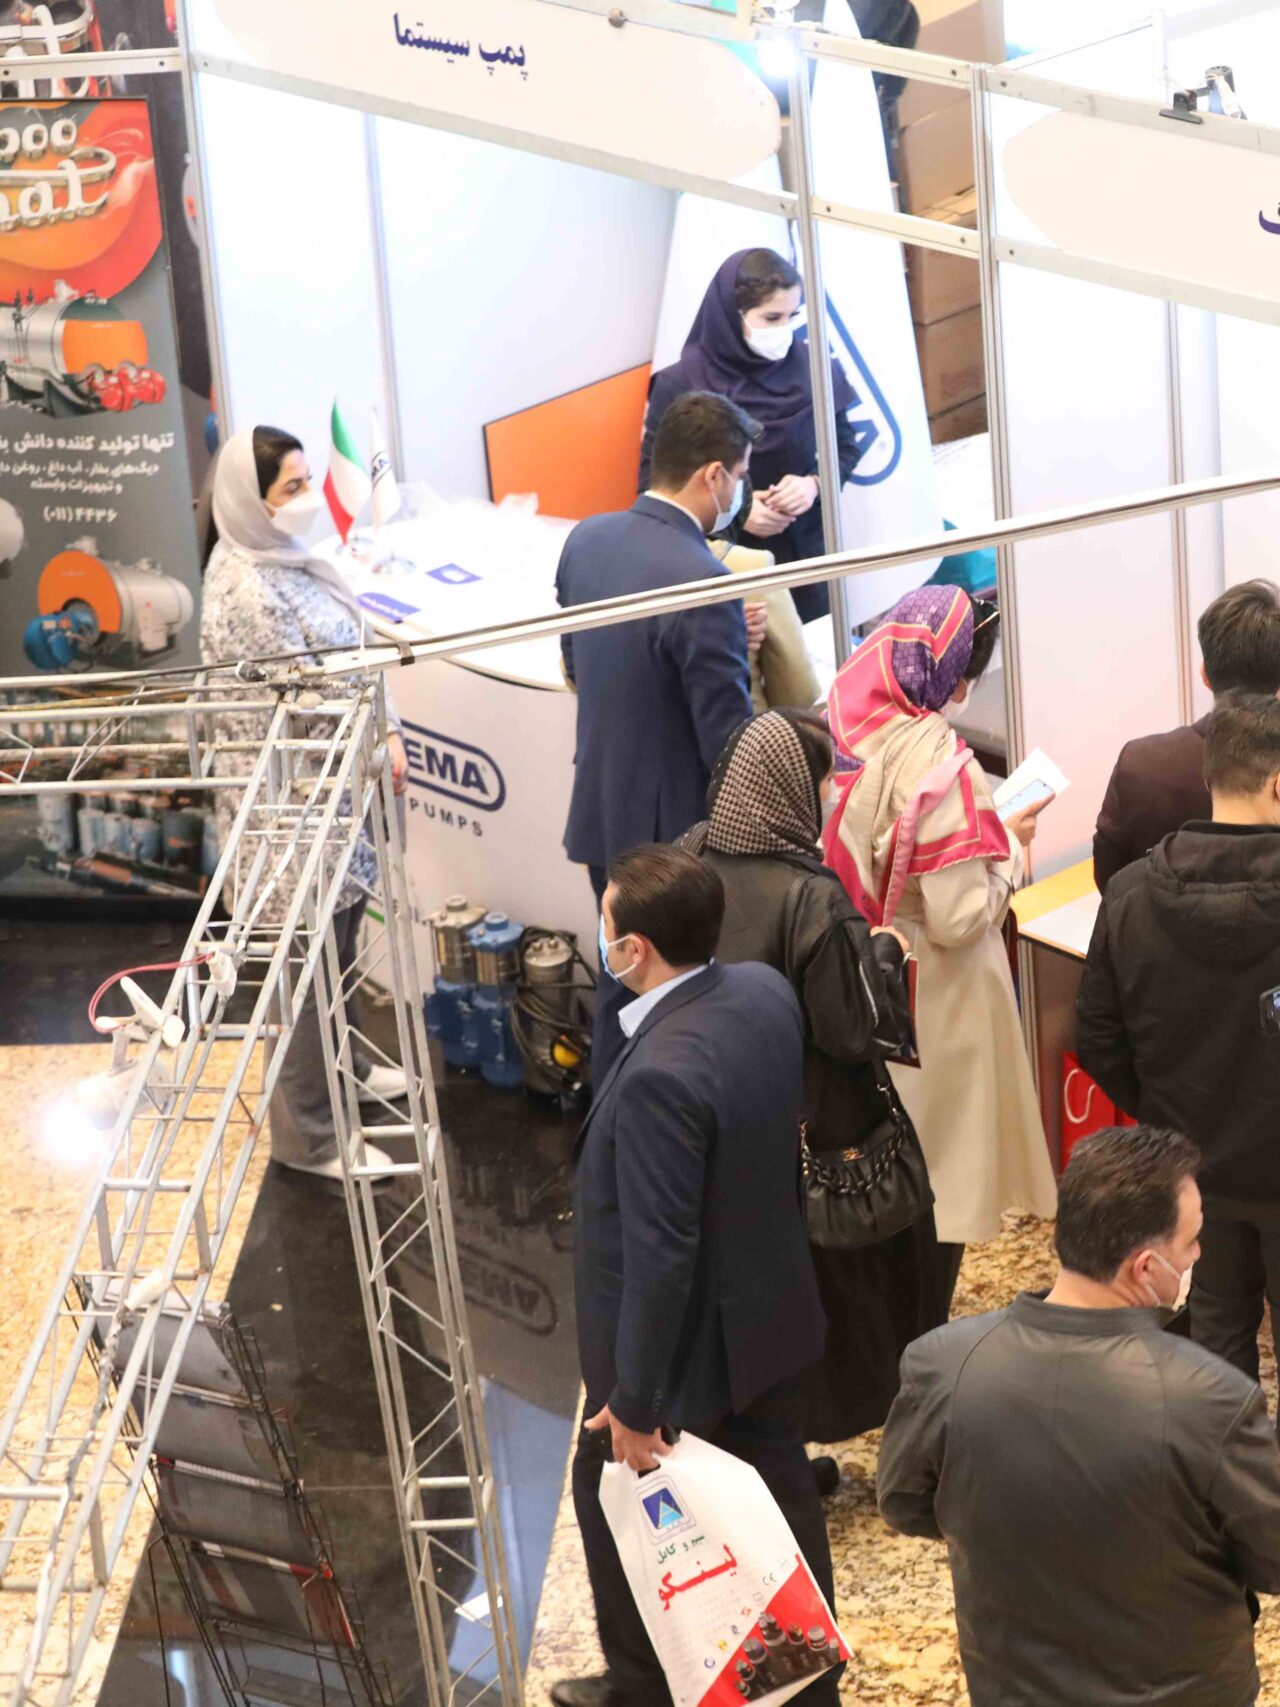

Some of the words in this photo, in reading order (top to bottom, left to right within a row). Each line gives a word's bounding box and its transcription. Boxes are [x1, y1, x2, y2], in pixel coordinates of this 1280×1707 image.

[393, 12, 471, 64] سیستما
[478, 42, 529, 81] پمپ
[13, 431, 55, 454] دانش
[56, 434, 96, 451] کننده
[98, 434, 140, 455] تولید
[142, 432, 175, 453] تنها
[403, 736, 491, 797] EMA
[409, 797, 483, 838] PUMPS
[657, 1543, 738, 1613] لینکو
